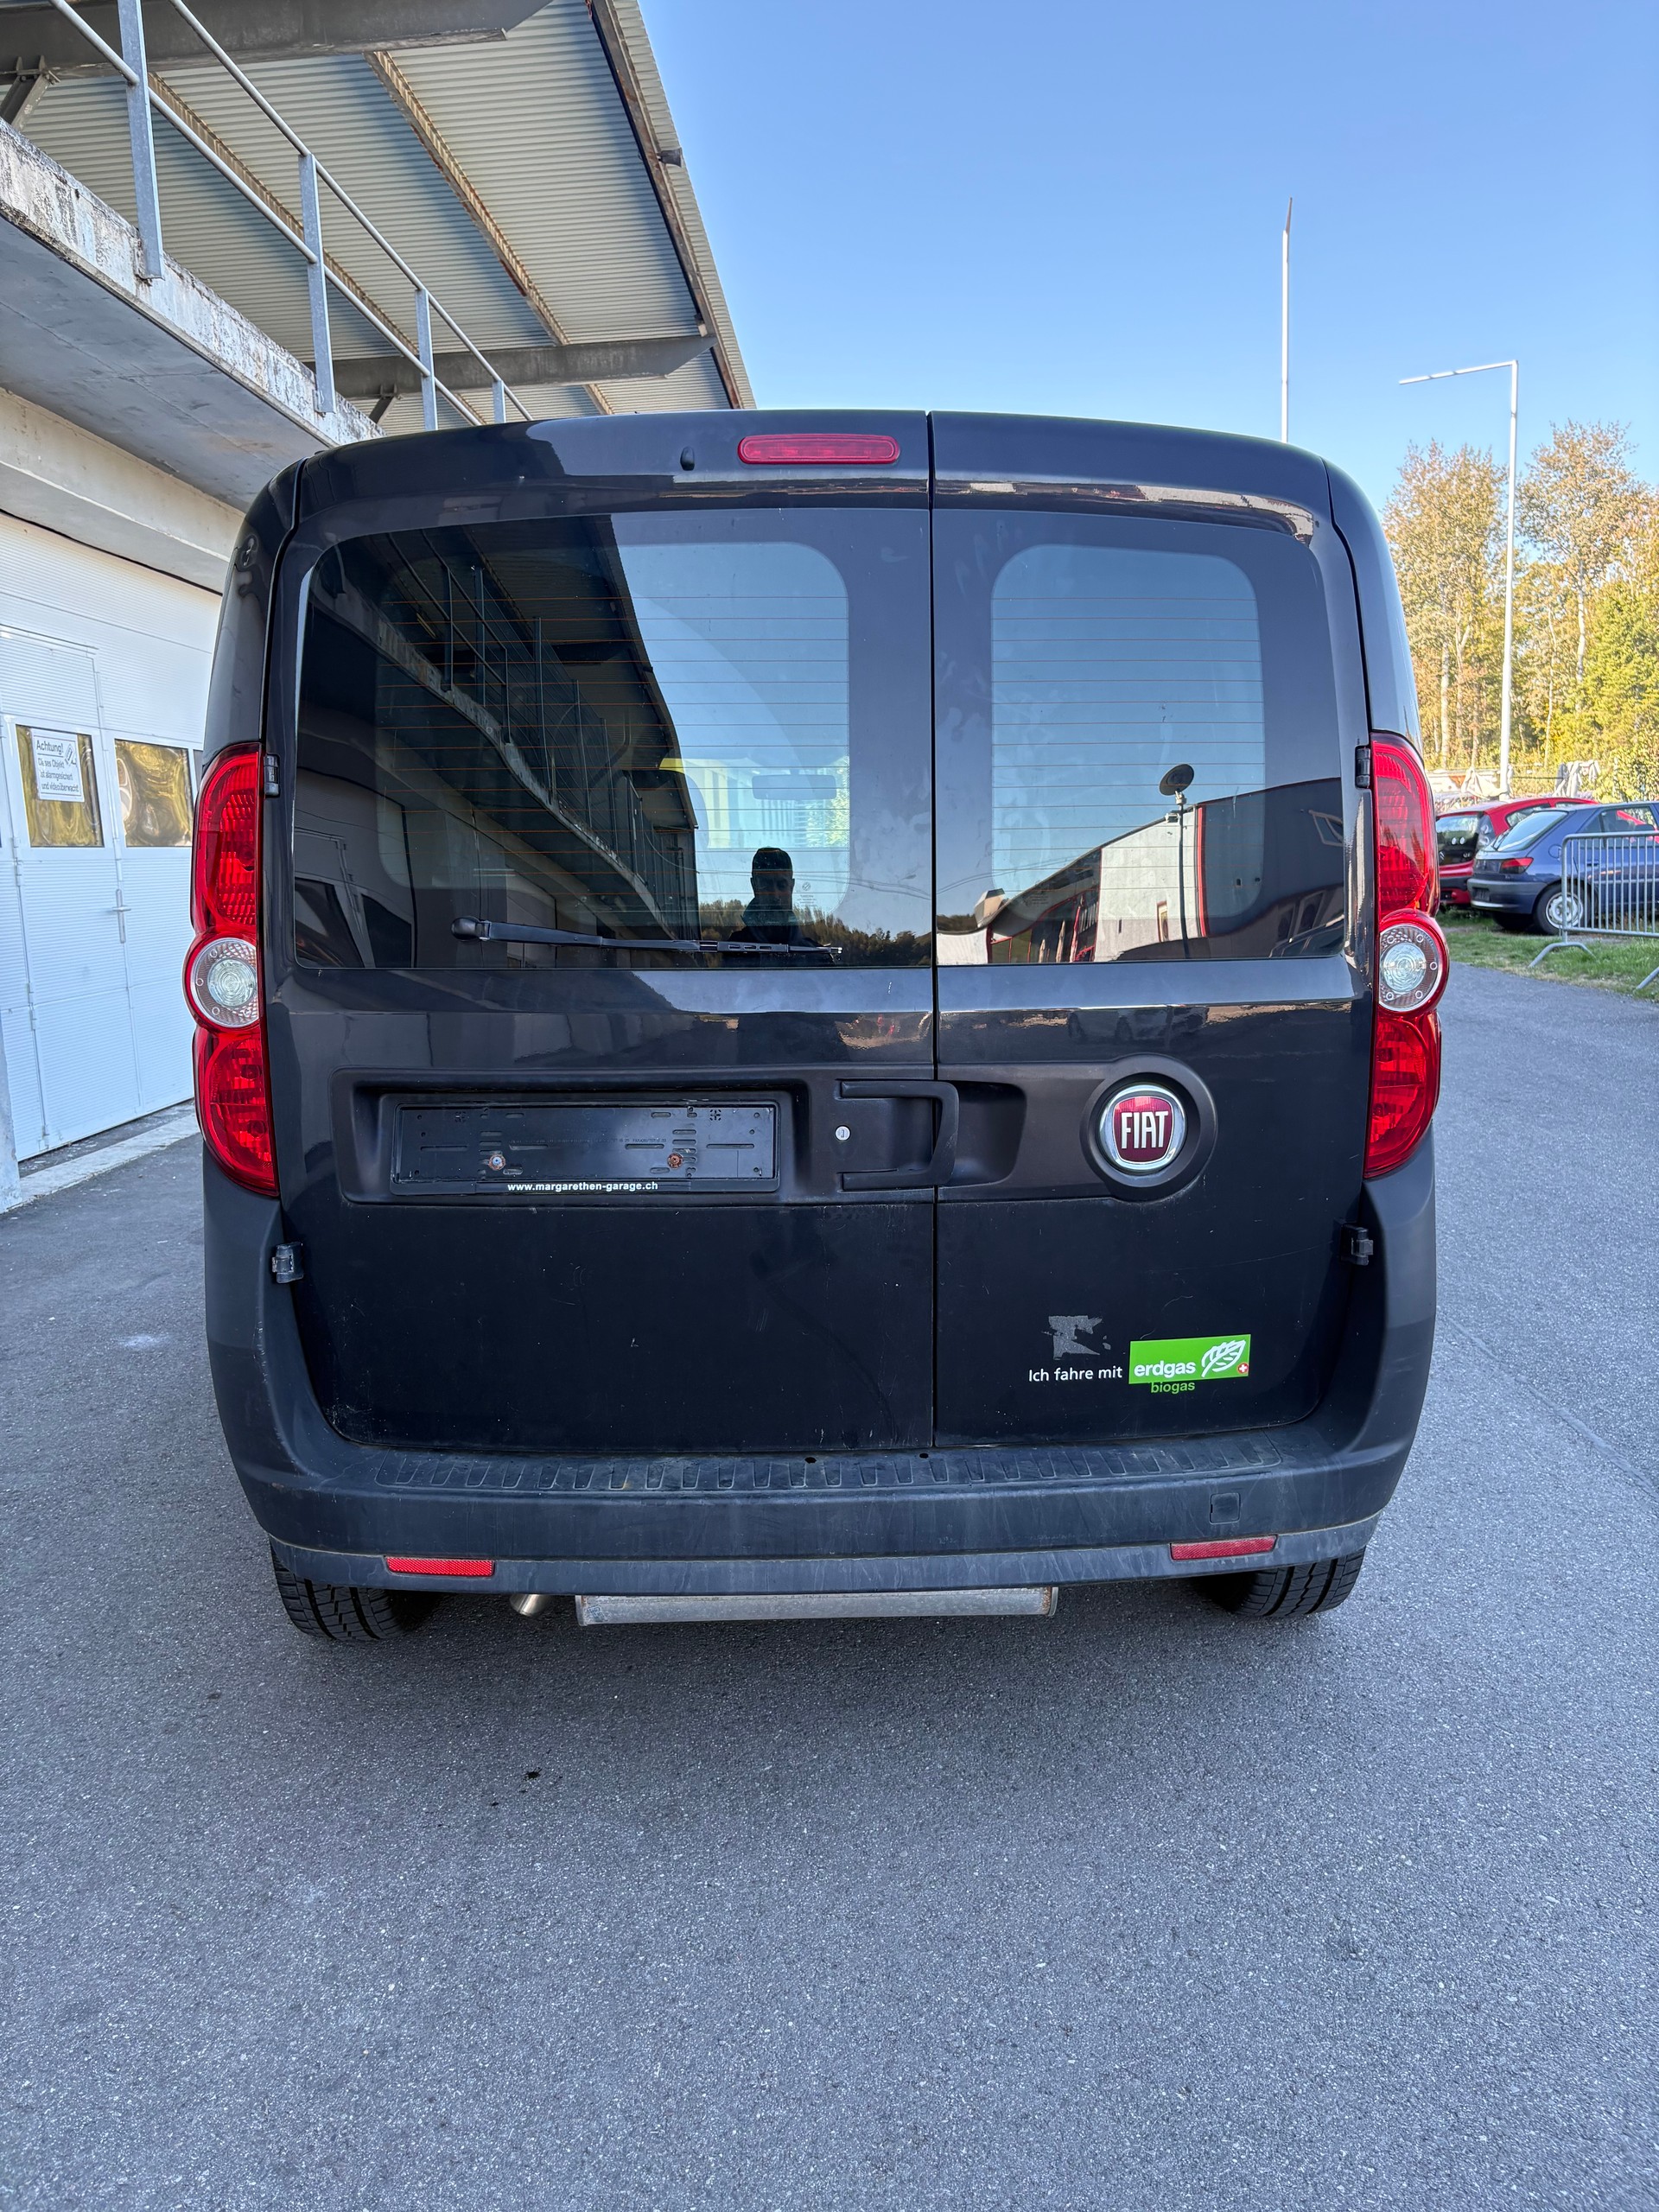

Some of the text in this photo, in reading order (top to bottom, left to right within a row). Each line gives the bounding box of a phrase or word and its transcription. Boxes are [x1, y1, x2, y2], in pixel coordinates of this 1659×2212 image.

[36, 740, 64, 755] Achtung!
[1122, 1111, 1168, 1149] FIAT
[507, 1181, 658, 1192] www.margarethen-garage.ch
[1028, 1360, 1196, 1382] Ich fahre mit erdgas
[1150, 1381, 1196, 1395] biogas
